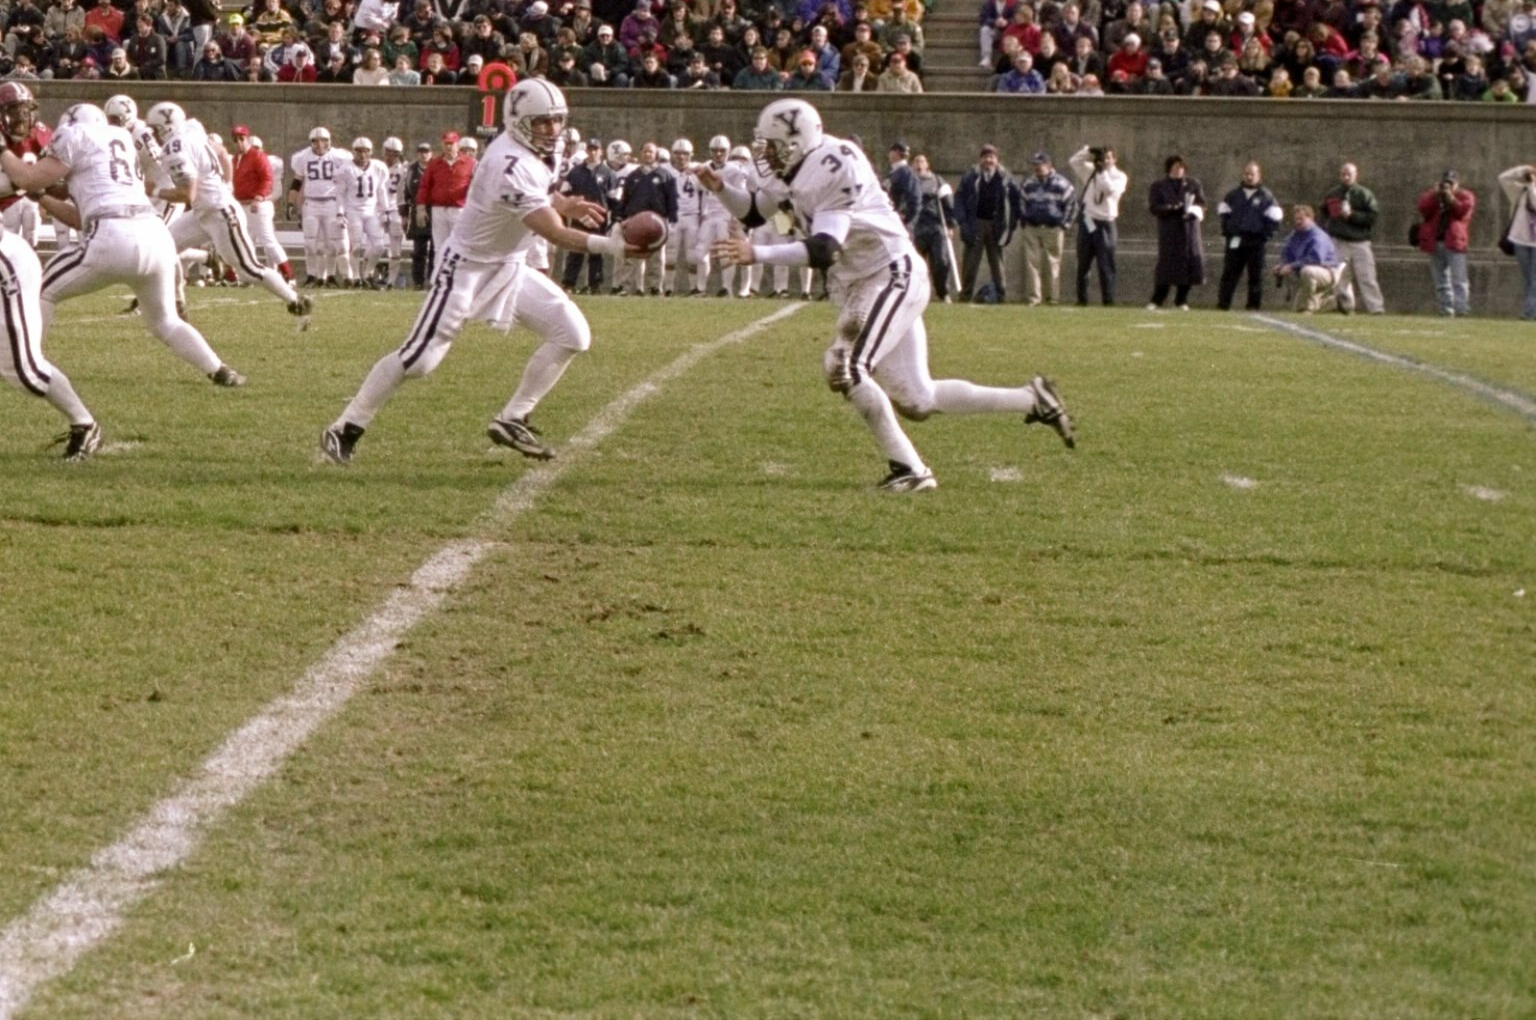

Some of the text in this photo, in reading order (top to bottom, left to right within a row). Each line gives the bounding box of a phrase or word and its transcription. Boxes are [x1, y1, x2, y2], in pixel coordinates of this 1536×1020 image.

[481, 95, 496, 128] 1
[509, 88, 528, 117] Y
[158, 108, 174, 125] Y
[772, 107, 802, 136] Y
[307, 160, 334, 181] 50
[504, 155, 520, 175] 7
[356, 175, 374, 198] 11
